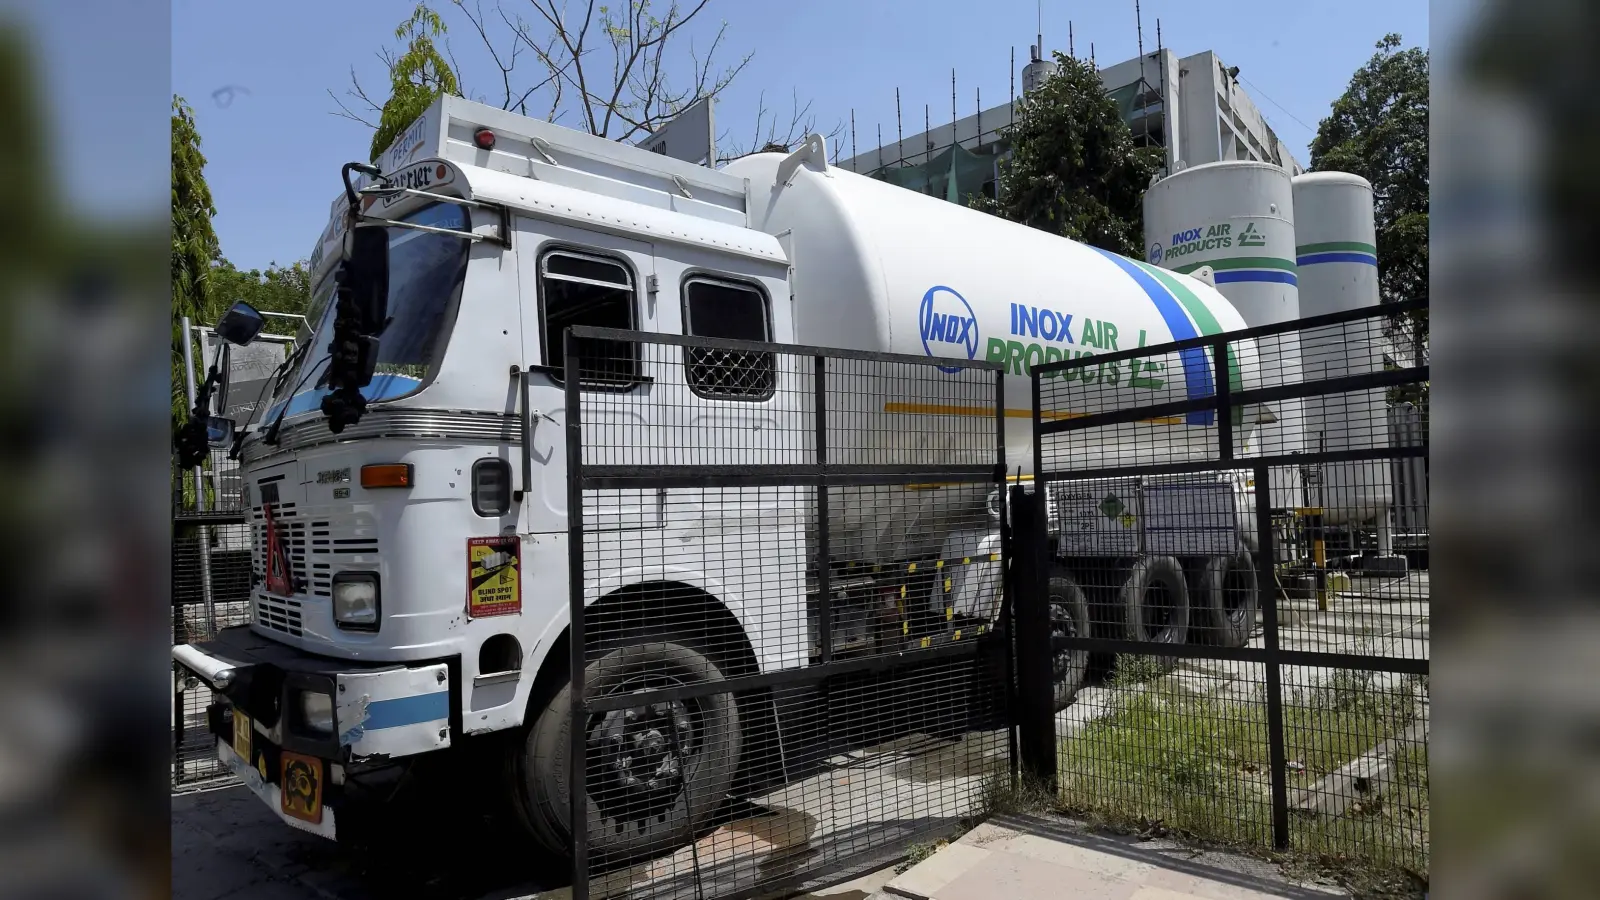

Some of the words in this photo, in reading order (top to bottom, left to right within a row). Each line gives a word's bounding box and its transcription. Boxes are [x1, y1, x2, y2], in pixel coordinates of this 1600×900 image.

[393, 121, 424, 167] PERMIT
[1164, 236, 1232, 261] PRODUCTS
[1172, 228, 1203, 246] INOX
[1206, 223, 1232, 238] AIR
[921, 297, 976, 356] INOX
[1010, 302, 1074, 344] INOX
[1080, 317, 1119, 351] AIR
